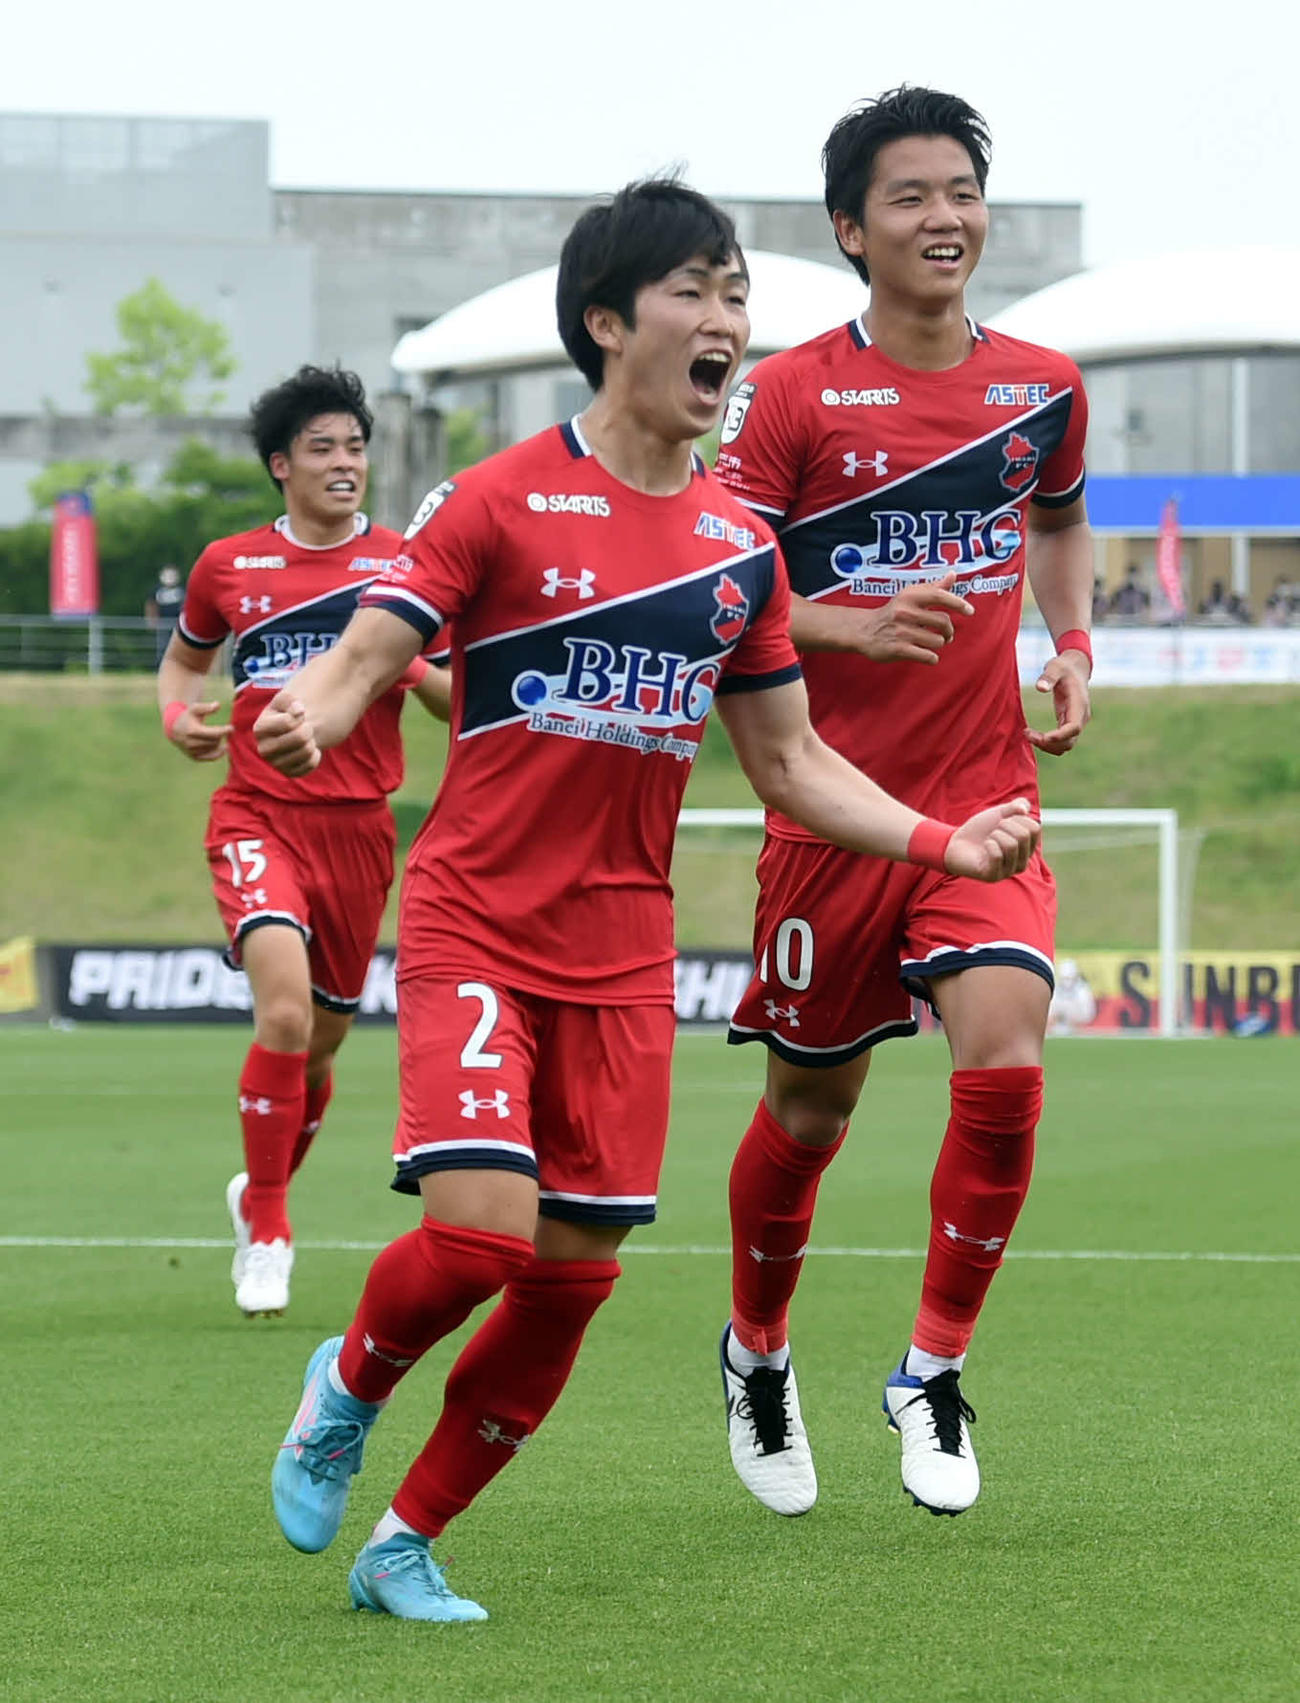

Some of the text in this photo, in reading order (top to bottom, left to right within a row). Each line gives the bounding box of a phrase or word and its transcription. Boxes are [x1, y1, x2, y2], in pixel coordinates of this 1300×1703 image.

[841, 387, 901, 406] STARTS
[548, 494, 611, 517] STARTS
[585, 718, 660, 753] Holdings
[222, 839, 267, 888] 15
[457, 976, 503, 1068] 2
